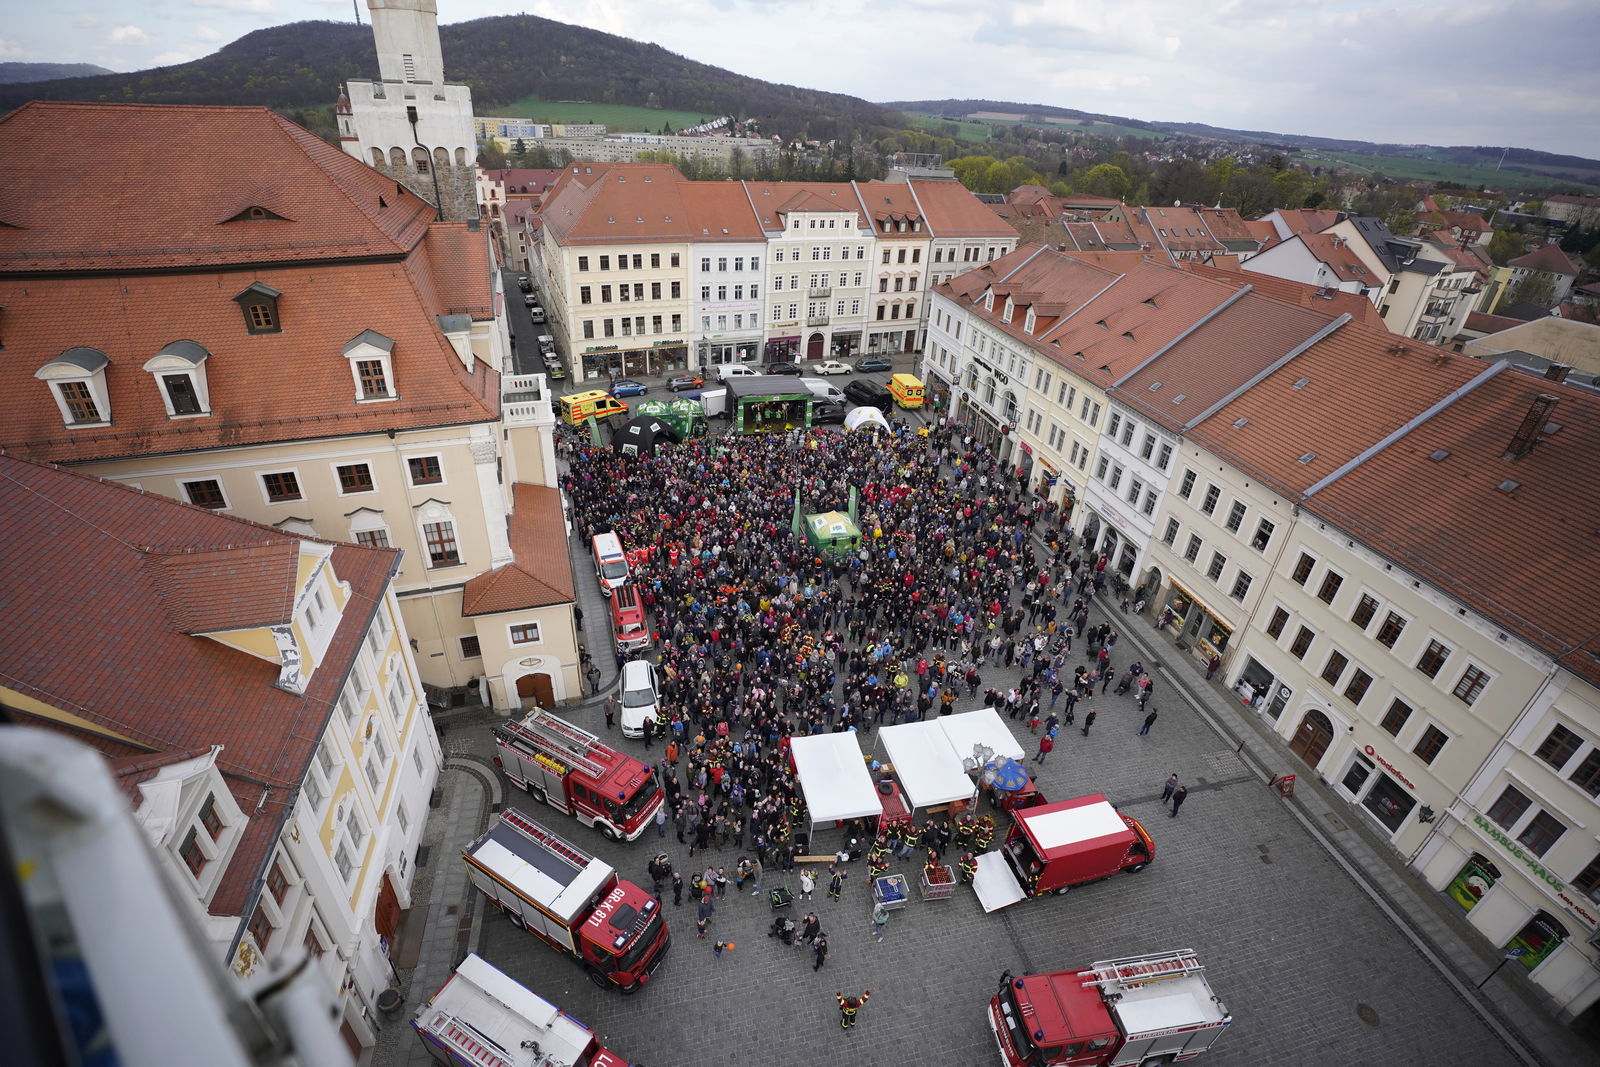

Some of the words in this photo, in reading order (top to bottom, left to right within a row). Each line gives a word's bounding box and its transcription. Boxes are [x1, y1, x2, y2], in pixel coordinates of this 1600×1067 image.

[1376, 755, 1415, 790] vodafone
[1473, 815, 1565, 892] BAMBUS-HAUS
[601, 888, 625, 912] GR-K
[588, 910, 607, 927] 811
[628, 913, 657, 950] FEUERWEHR
[995, 1004, 1015, 1057] FEUERWEHR
[1134, 1029, 1178, 1040] FEUERWEHR
